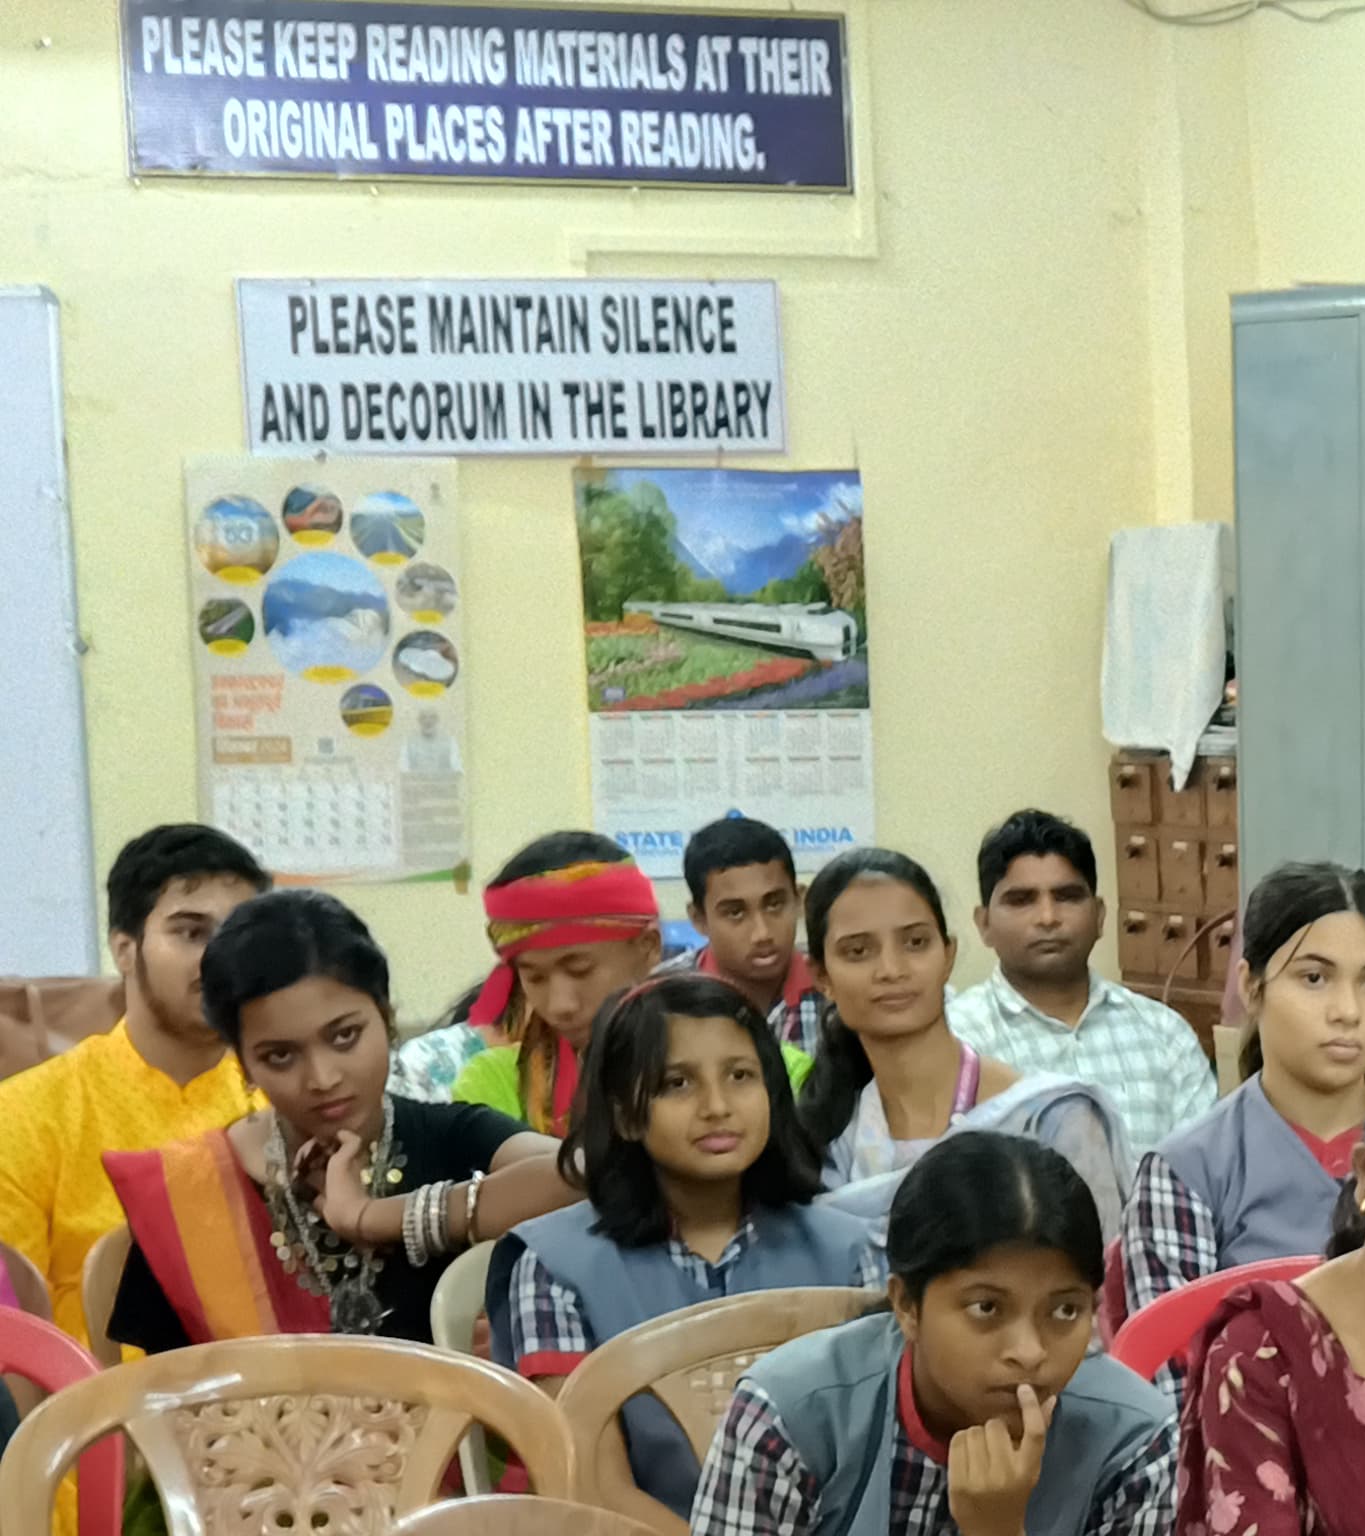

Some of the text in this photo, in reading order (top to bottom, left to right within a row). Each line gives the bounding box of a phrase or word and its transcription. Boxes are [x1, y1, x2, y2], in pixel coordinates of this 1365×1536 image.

[141, 15, 832, 96] PLEASE KEEP READING MATERIALS AT THEIR
[223, 97, 767, 172] ORIGINAL PLACES AFTER READING.
[288, 293, 738, 355] PLEASE MAINTAIN SILENCE
[260, 379, 772, 443] AND DECORUM IN THE LIBRARY
[615, 827, 854, 849] STATE INDIA
